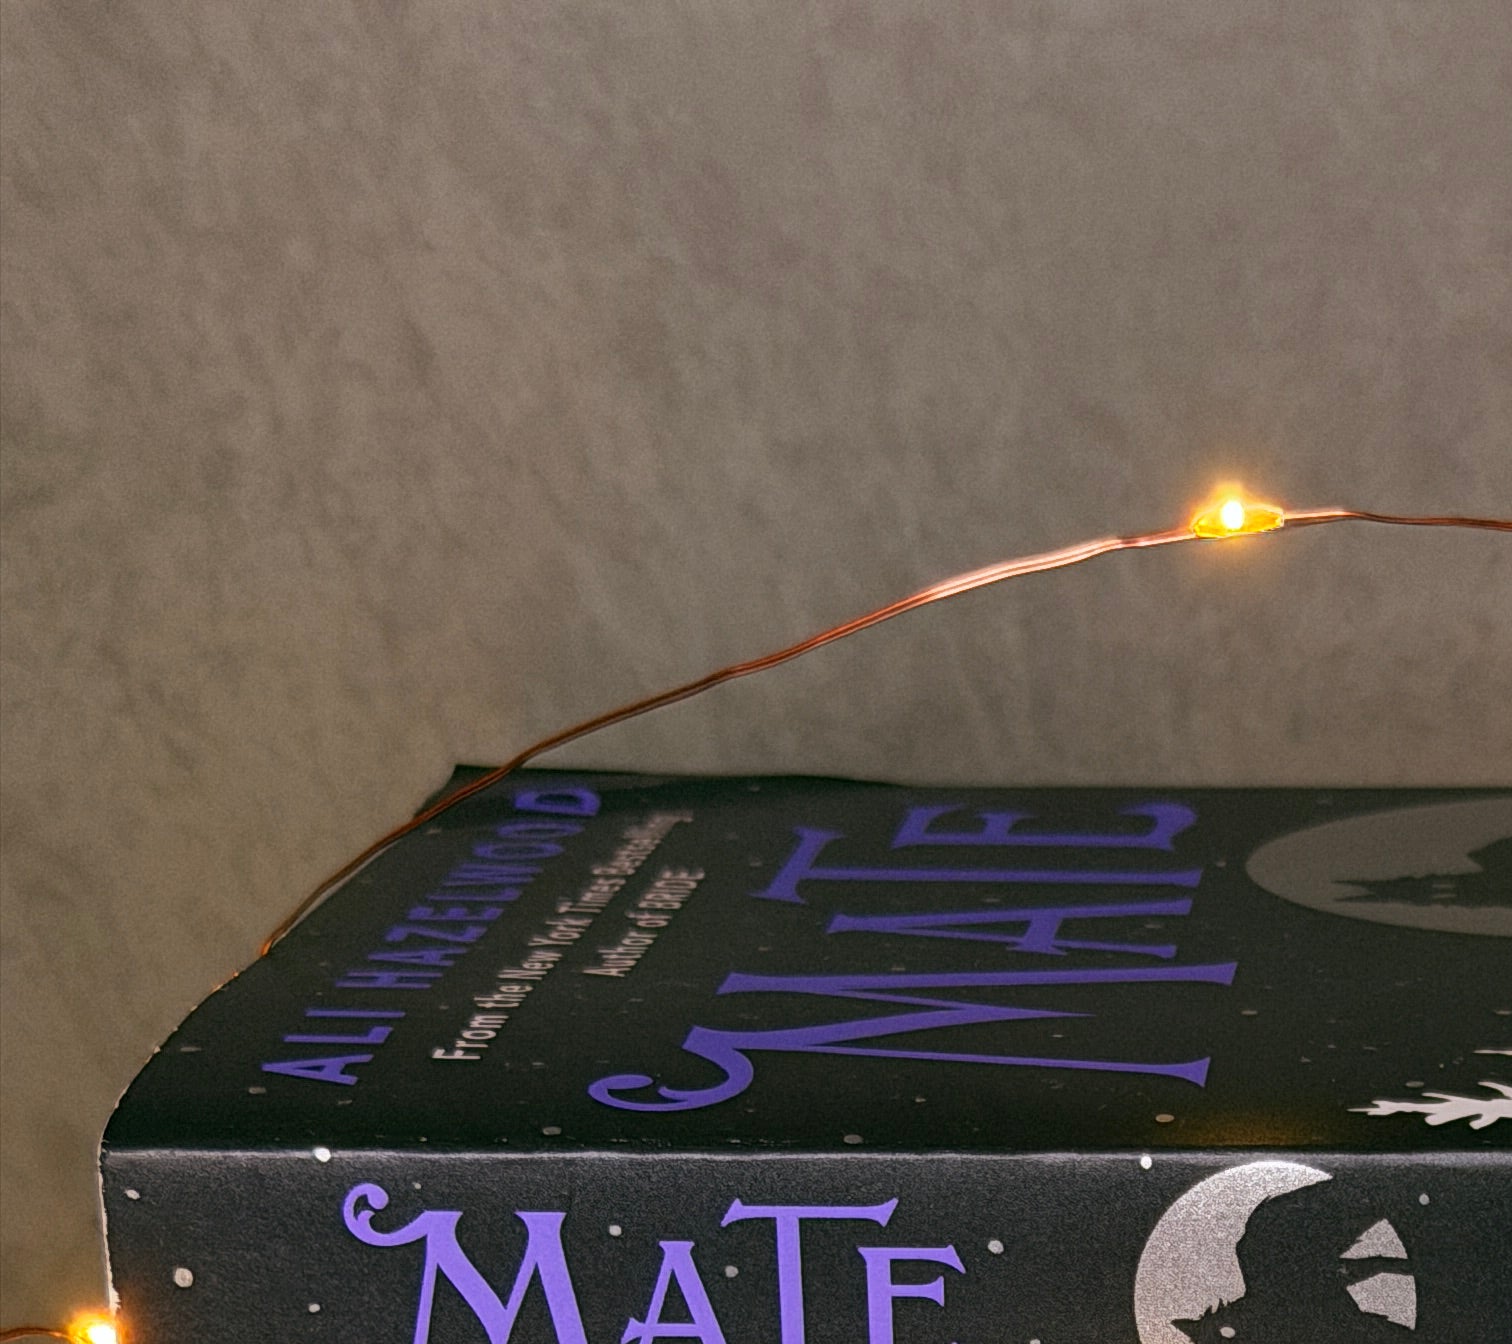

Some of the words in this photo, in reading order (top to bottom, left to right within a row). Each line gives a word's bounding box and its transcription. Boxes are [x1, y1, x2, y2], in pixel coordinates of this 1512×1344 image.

[555, 878, 627, 914] Times
[637, 867, 705, 910] BRIDE
[261, 1008, 406, 1085] ALI
[335, 785, 601, 989] HAZELWOOD
[527, 917, 594, 947] York
[625, 910, 673, 928] of
[497, 949, 563, 981] New
[582, 929, 659, 978] Author
[588, 801, 1239, 1113] MATE
[474, 984, 534, 1009] the
[429, 1013, 510, 1060] From
